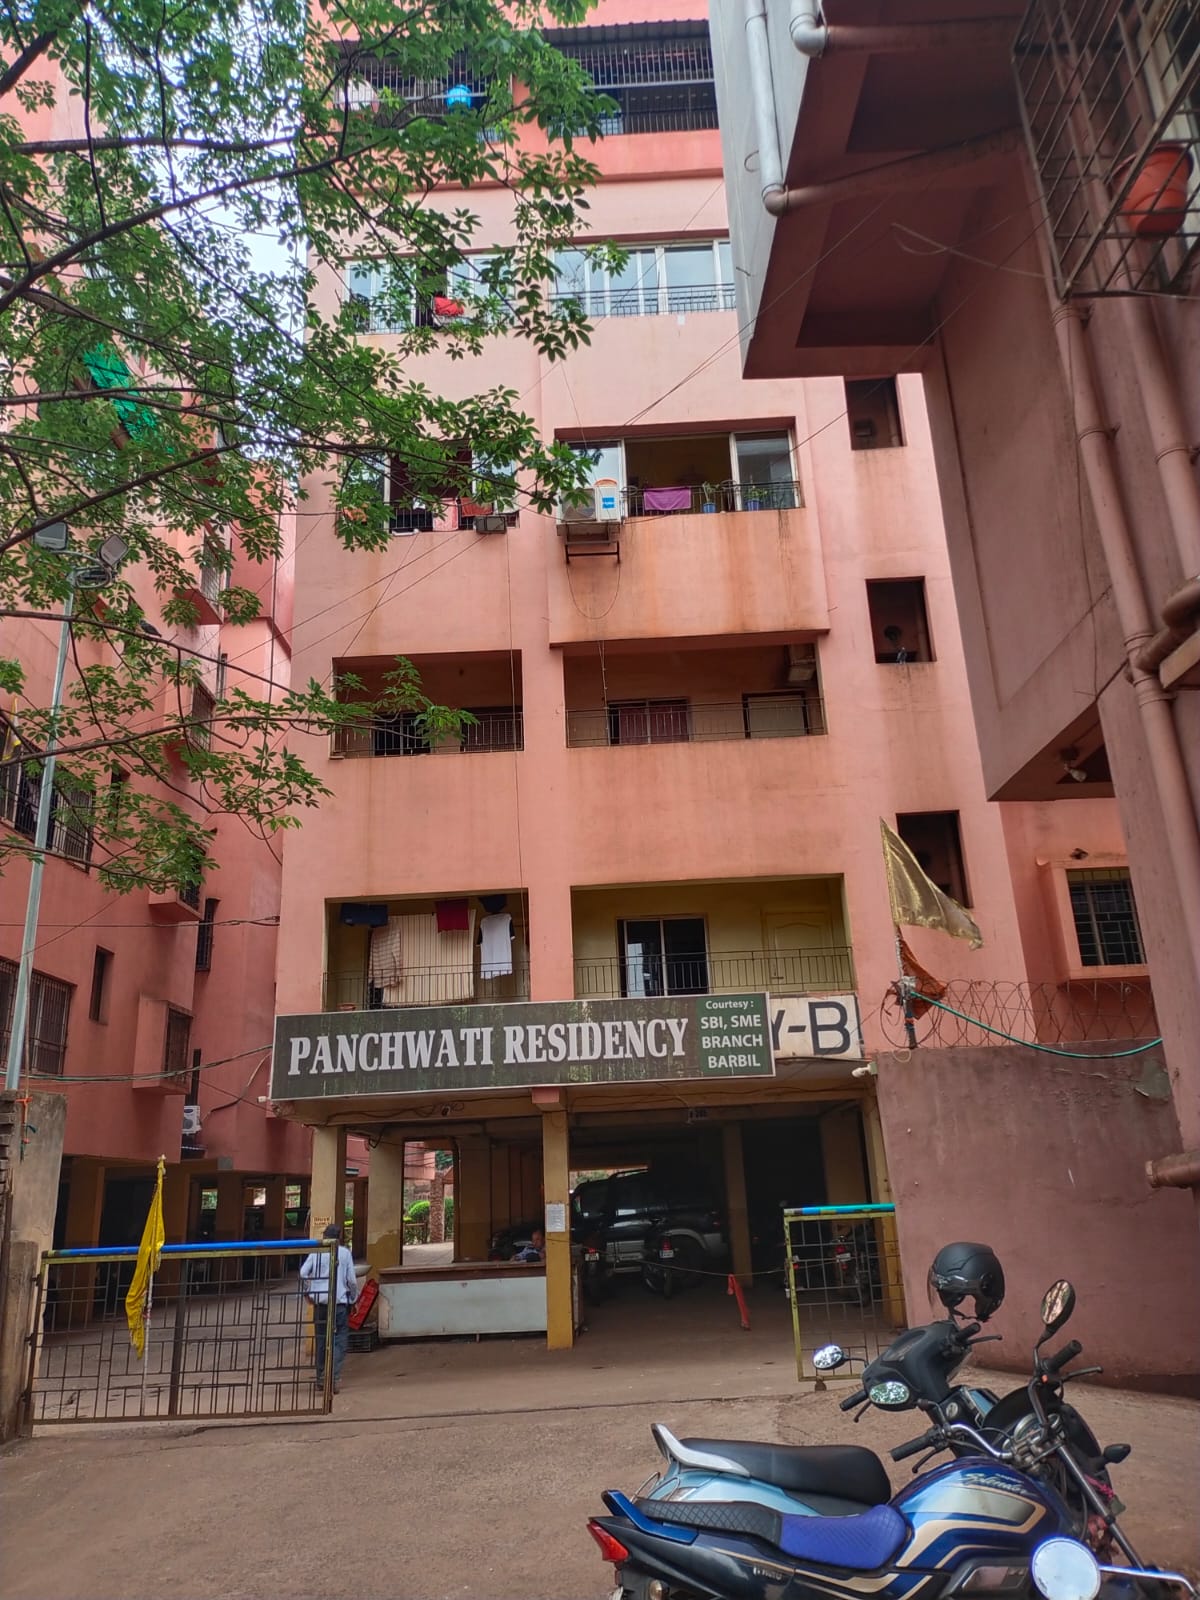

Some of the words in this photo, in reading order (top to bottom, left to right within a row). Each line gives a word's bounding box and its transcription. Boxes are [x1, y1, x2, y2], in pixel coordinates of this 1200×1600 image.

[700, 1016, 728, 1030] SBI,
[730, 1014, 762, 1028] SME
[288, 1027, 493, 1076] PANCHWATI
[503, 1018, 689, 1064] RESIDENCY
[702, 1033, 763, 1049] BRANCH
[708, 1053, 761, 1069] BARBIL
